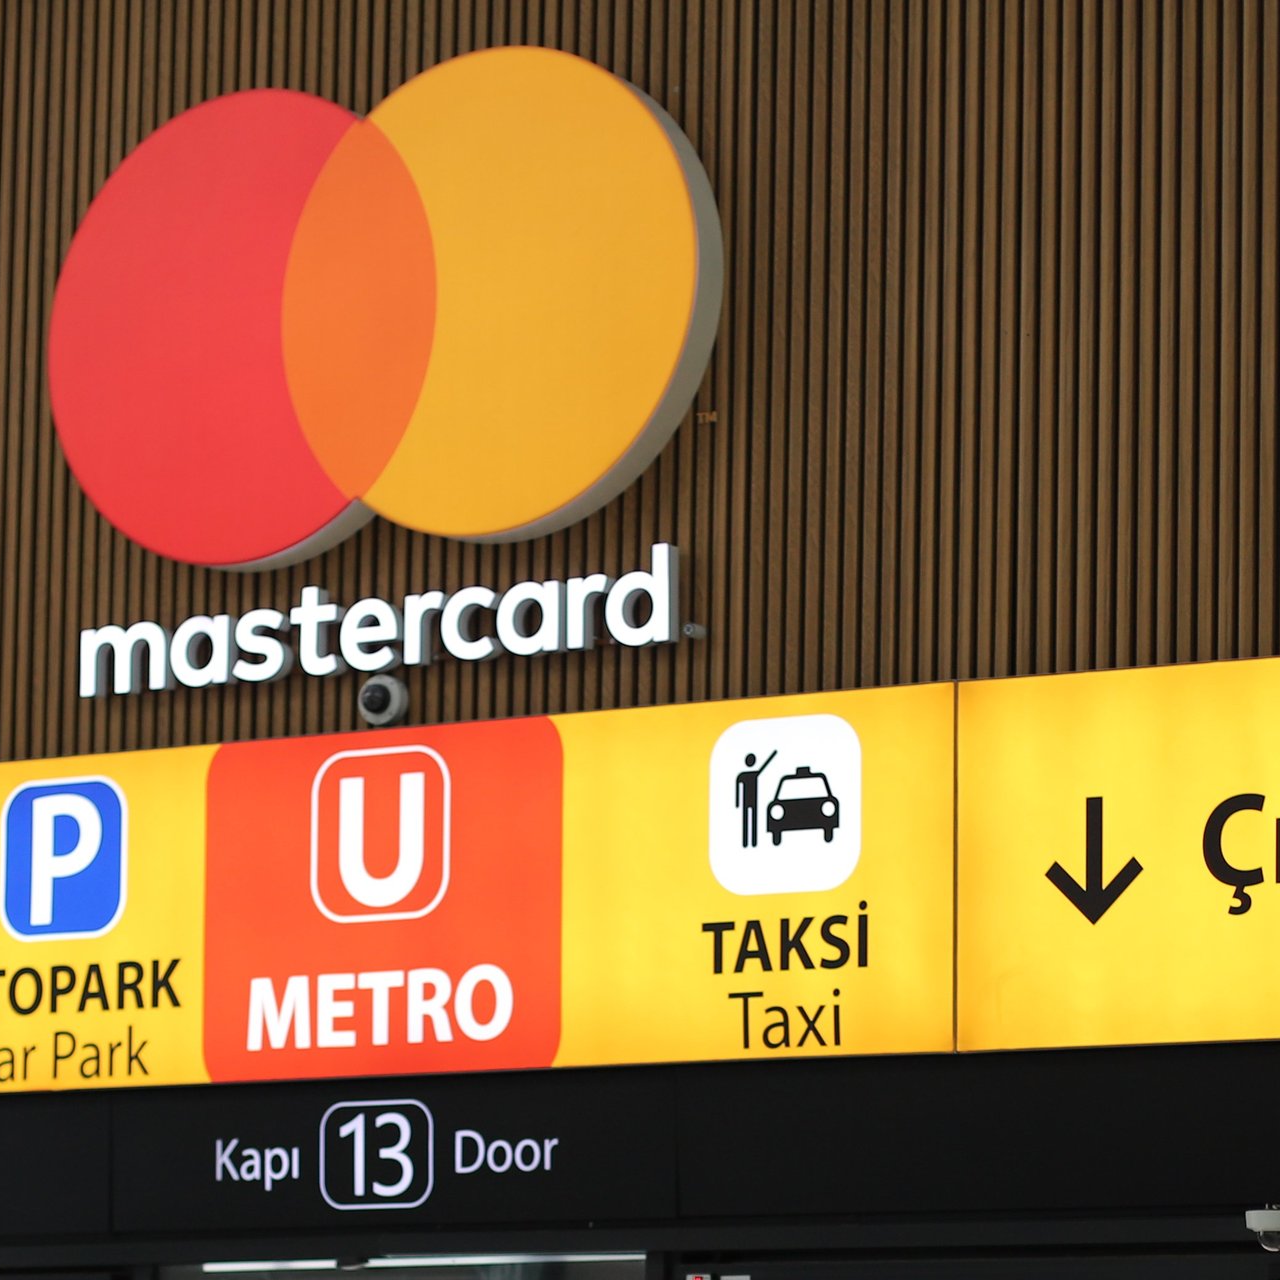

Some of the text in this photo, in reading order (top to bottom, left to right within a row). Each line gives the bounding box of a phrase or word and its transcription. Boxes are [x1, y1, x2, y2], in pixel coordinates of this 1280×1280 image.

[78, 541, 678, 698] mastercard
[29, 792, 104, 927] P
[338, 771, 426, 908] U
[700, 899, 869, 975] TAKSİ
[51, 1024, 150, 1080] Park
[245, 963, 515, 1053] METRO
[727, 987, 842, 1050] Taxi
[214, 1111, 559, 1198] Kapı 13 Door
